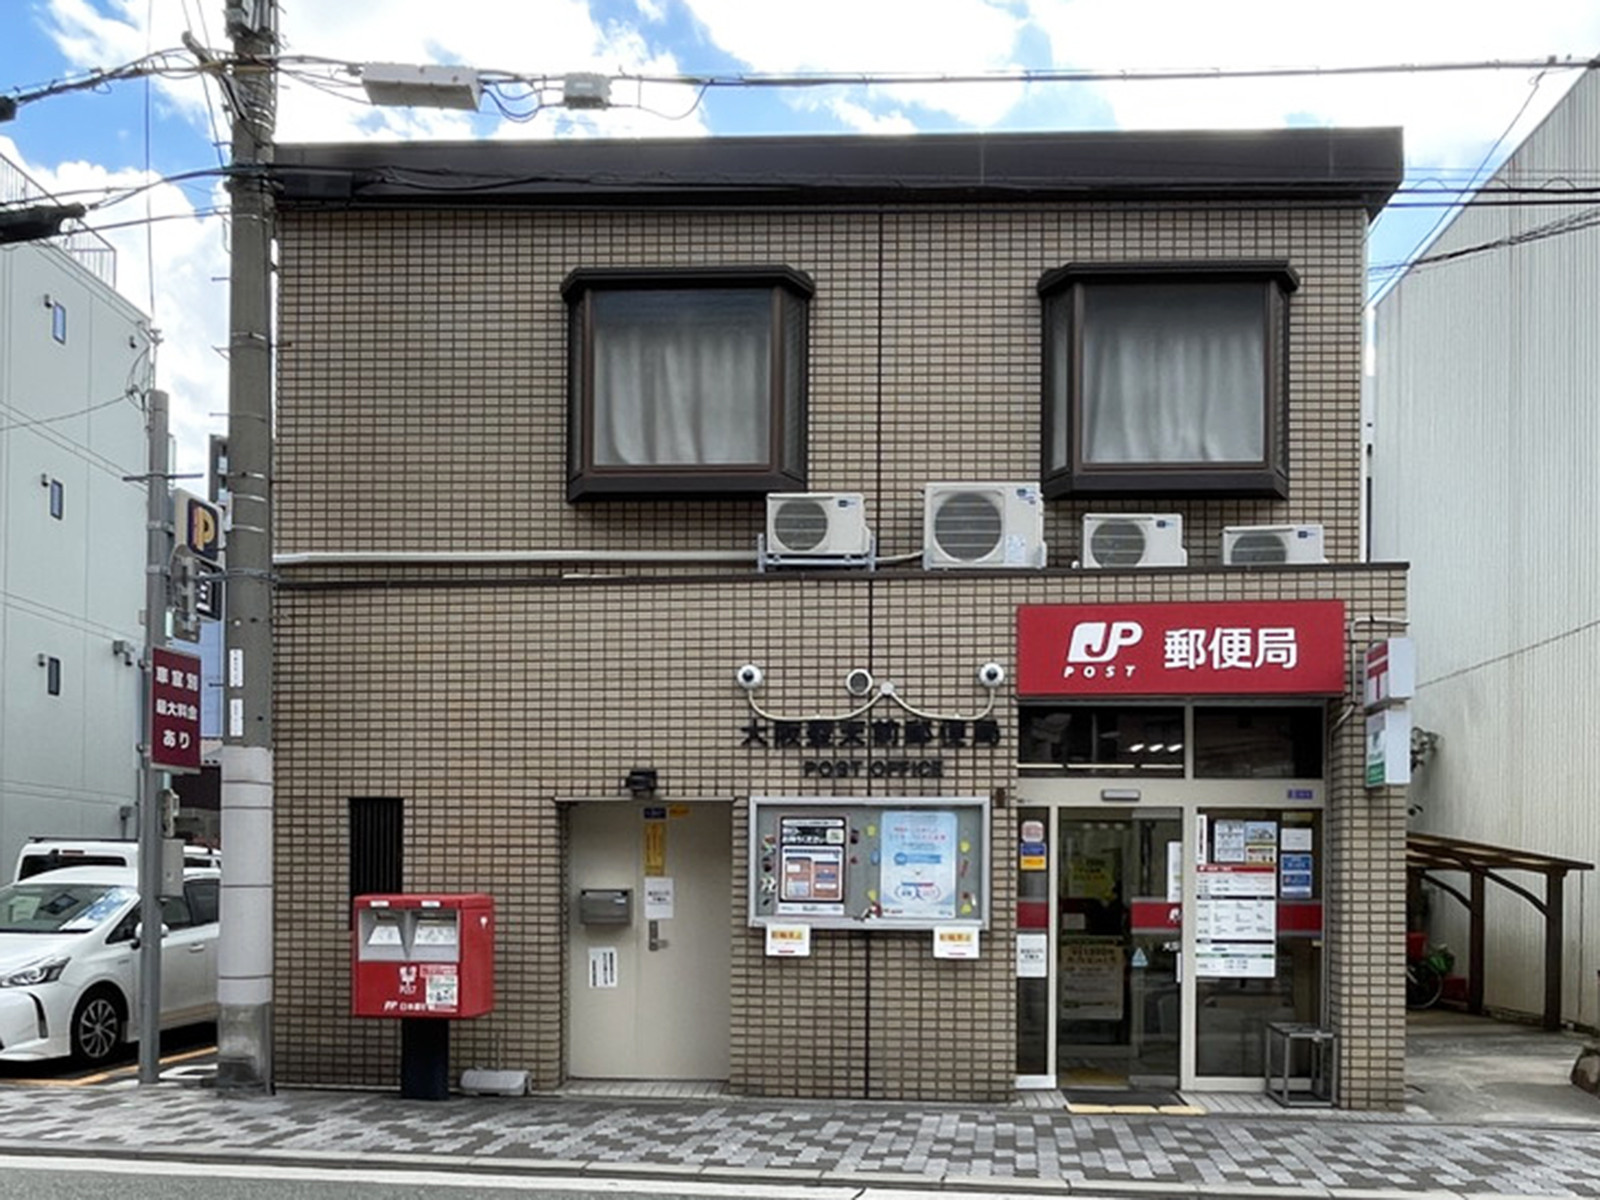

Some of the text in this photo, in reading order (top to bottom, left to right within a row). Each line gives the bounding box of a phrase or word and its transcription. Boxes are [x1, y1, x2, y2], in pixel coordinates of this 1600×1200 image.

[1067, 621, 1143, 663] JP
[1164, 627, 1298, 670] 郵便局
[1063, 665, 1137, 678] POST
[156, 698, 198, 722] 最大料金
[163, 729, 191, 749] あり
[804, 760, 944, 778] POST OFFICE
